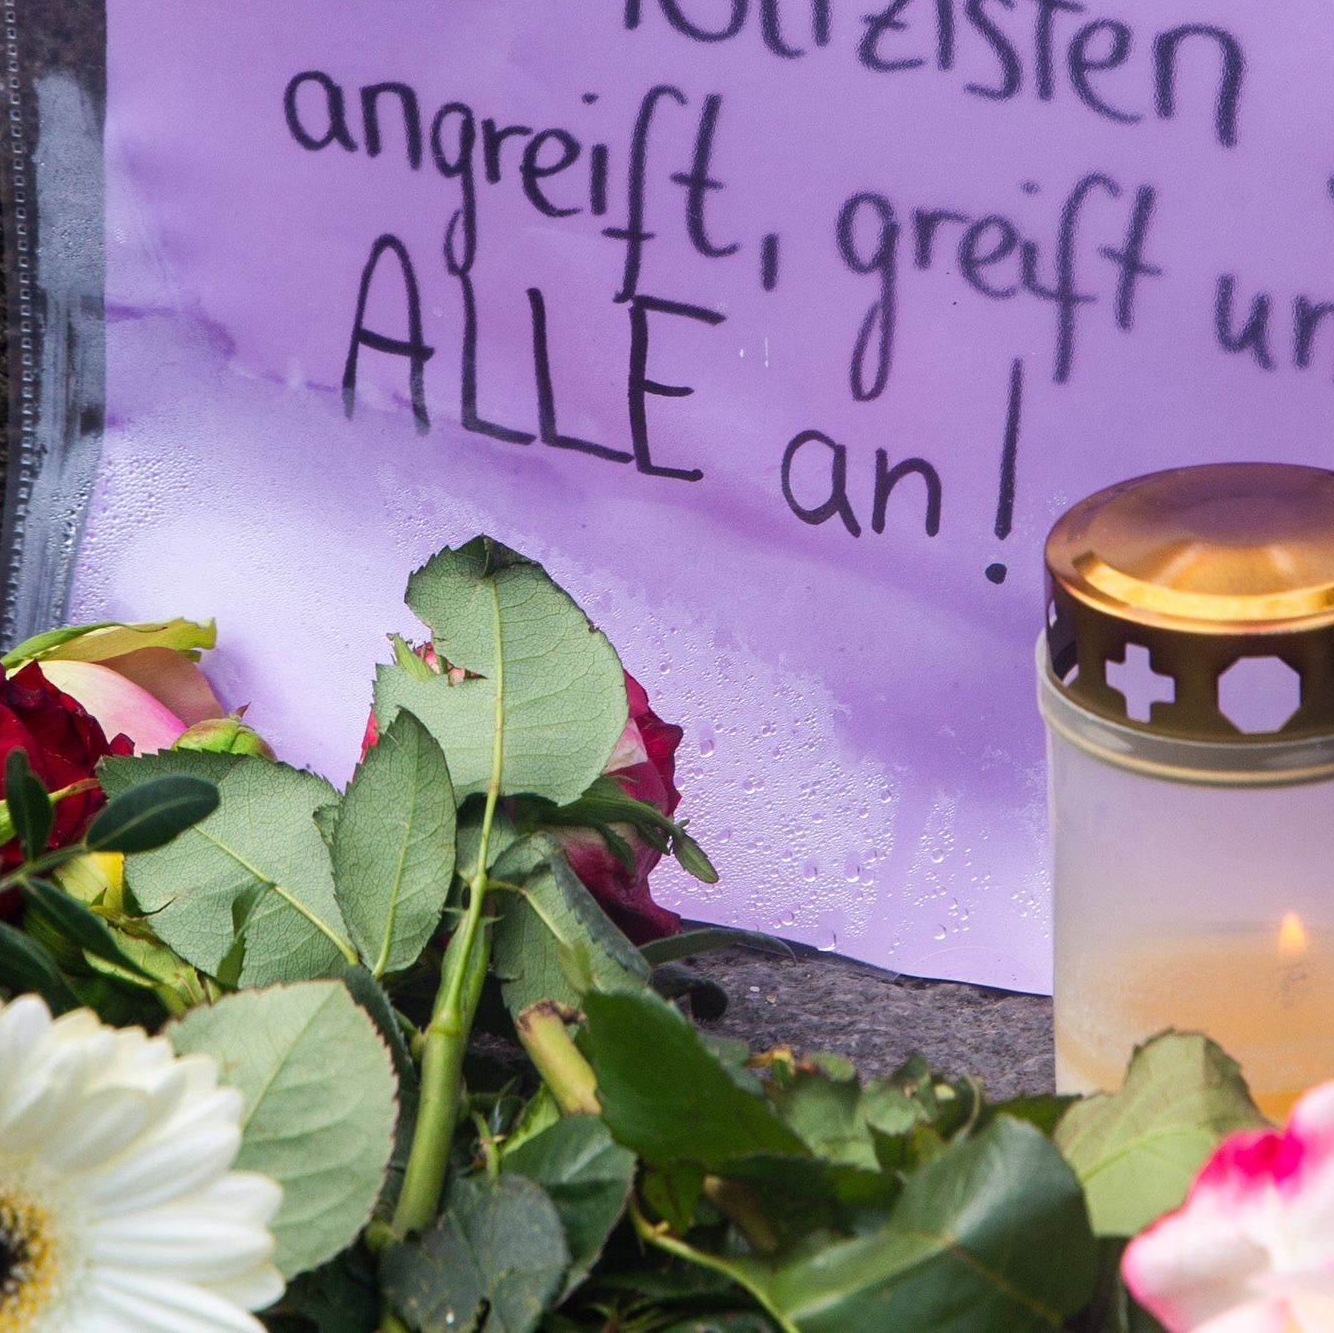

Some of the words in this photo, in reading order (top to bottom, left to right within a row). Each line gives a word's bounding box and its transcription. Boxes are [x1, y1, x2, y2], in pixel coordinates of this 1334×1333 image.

[284, 69, 778, 304] angreift,
[836, 171, 1162, 402] greift
[343, 235, 725, 481] ALLE
[780, 356, 1020, 585] an!
